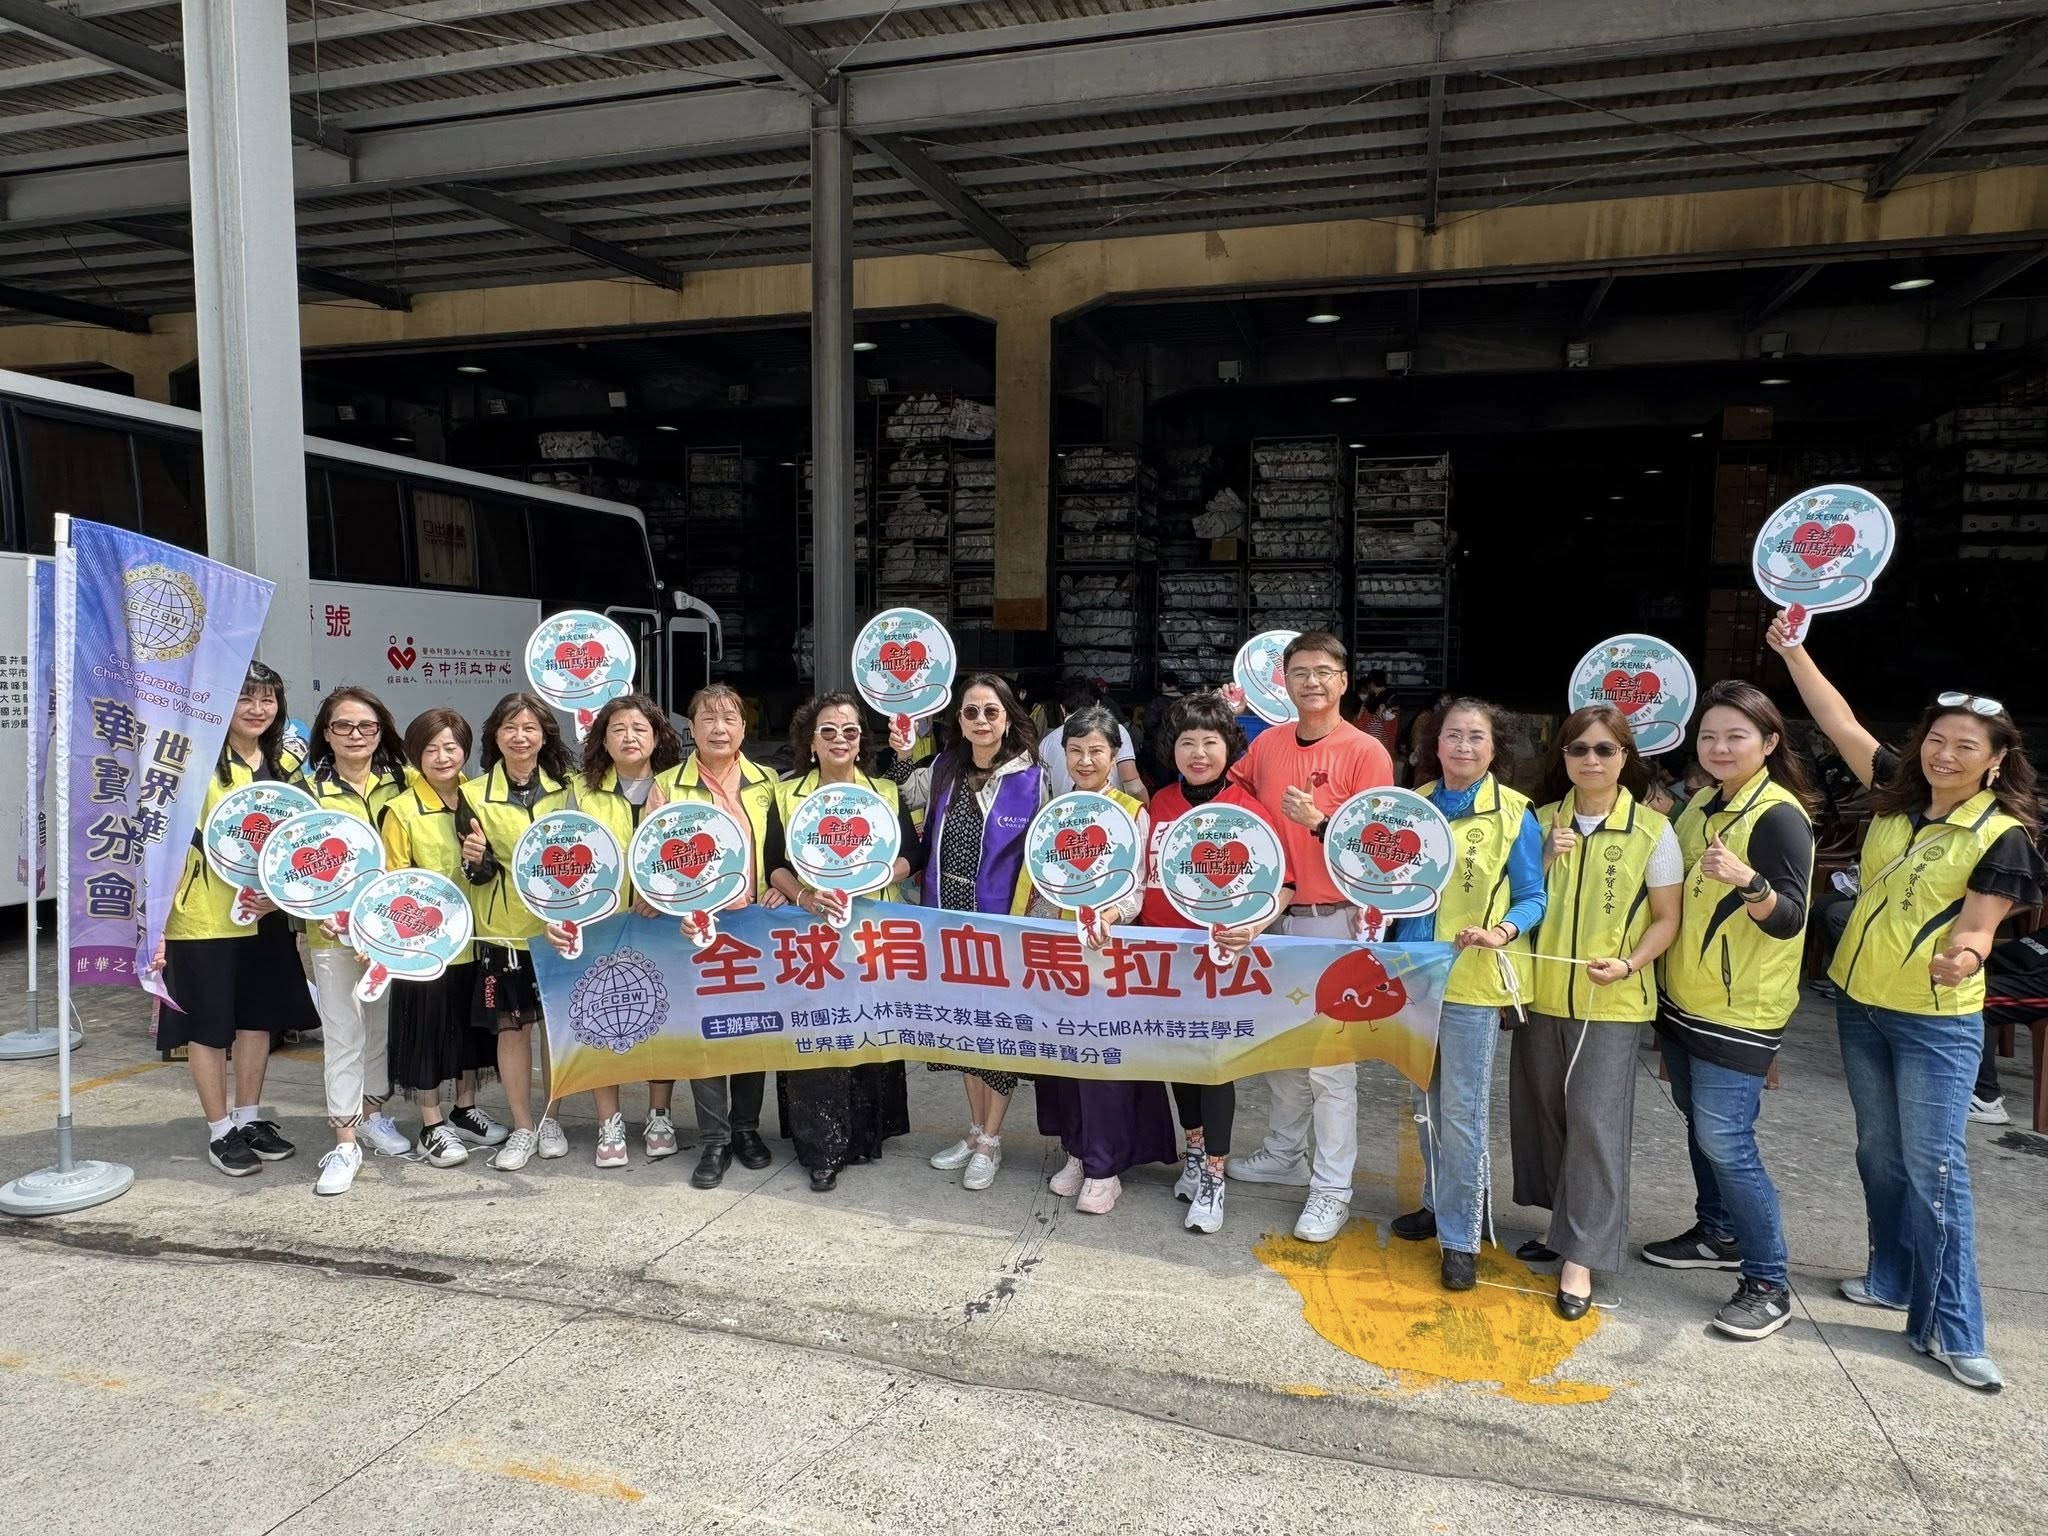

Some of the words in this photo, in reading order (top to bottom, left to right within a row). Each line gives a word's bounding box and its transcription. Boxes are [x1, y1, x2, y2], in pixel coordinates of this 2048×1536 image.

[1806, 529, 1834, 541] 全球
[1777, 540, 1855, 558] 捐血馬拉松
[130, 602, 182, 626] GFCBW
[325, 604, 351, 637] 號
[565, 647, 588, 658] 全球
[890, 647, 910, 658] 全球
[421, 661, 512, 678] 台中捐血中心
[546, 657, 610, 671] 捐血馬拉松
[871, 659, 930, 671] 捐血馬拉松
[135, 671, 190, 697] deration
[192, 691, 209, 703] of
[1615, 677, 1641, 688] 全球
[1590, 687, 1663, 704] 捐血馬拉松
[134, 686, 169, 707] iness
[173, 698, 222, 725] Women
[227, 824, 267, 844] 捐血馬
[829, 821, 852, 833] 全球
[807, 832, 873, 846] 捐血馬拉松
[1065, 833, 1089, 847] 全球
[1374, 830, 1400, 847] 全球
[303, 846, 328, 864] 全球
[552, 851, 575, 863] 全球
[672, 842, 697, 857] 全球
[1045, 842, 1112, 863] 捐血馬拉松
[1203, 848, 1230, 860] 全球
[1346, 837, 1422, 867] 捐血馬拉松
[284, 850, 357, 884] 捐血馬拉松
[532, 863, 597, 877] 捐血馬拉松
[652, 848, 722, 875] 捐血馬拉松
[1180, 860, 1253, 875] 捐血馬拉松
[401, 903, 425, 917] 全球
[374, 902, 440, 939] 捐血馬拉松
[692, 920, 1272, 998] 全球捐血馬拉松
[709, 1014, 779, 1036] 主辦單位
[795, 1029, 1122, 1064] 世界華人工商婦女企管協會華寶分會
